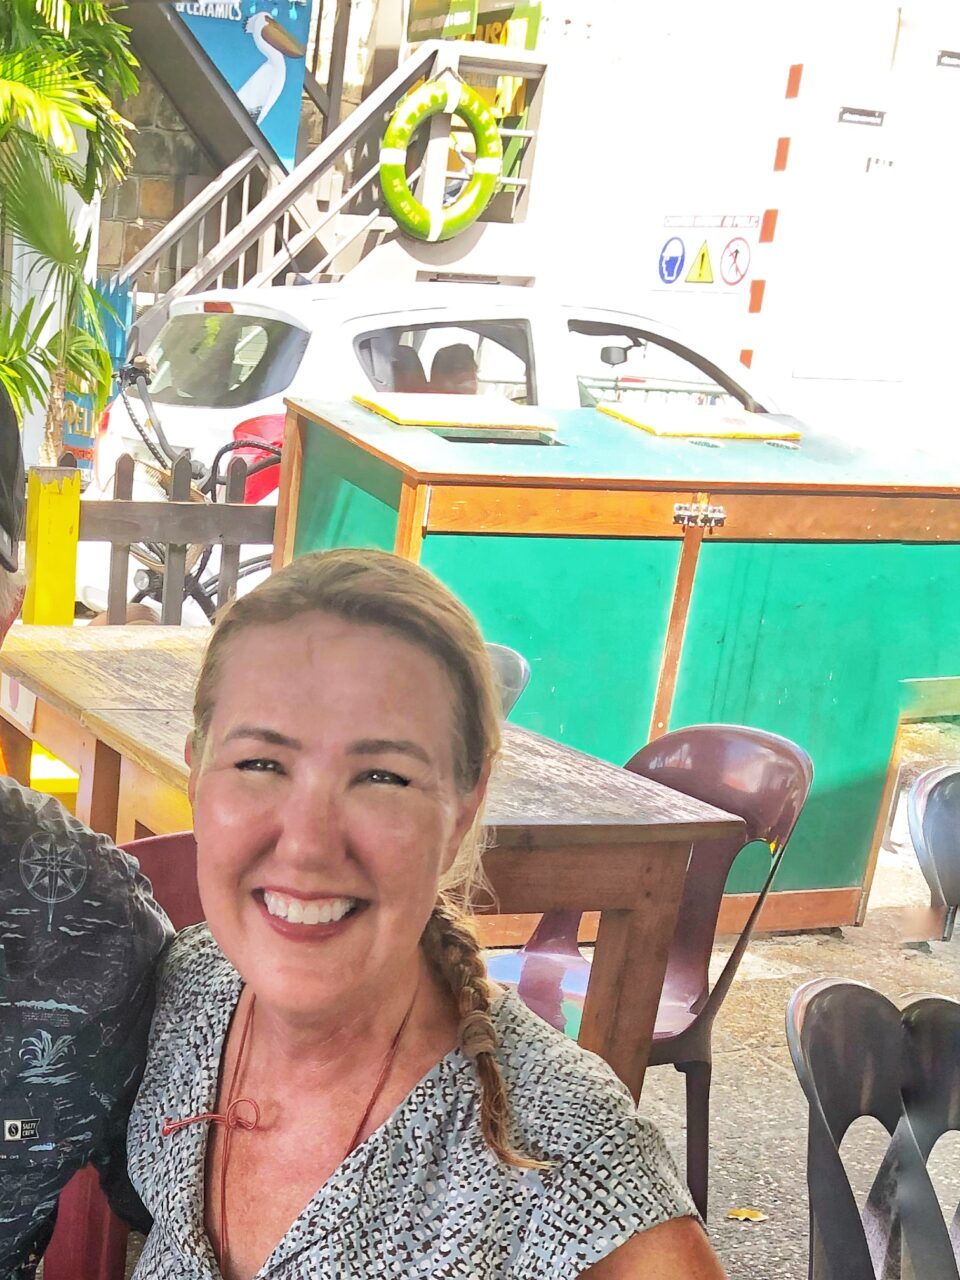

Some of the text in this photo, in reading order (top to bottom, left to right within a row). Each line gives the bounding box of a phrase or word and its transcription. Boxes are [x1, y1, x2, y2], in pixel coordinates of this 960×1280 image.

[186, 1, 242, 21] CERAMICS
[22, 1122, 36, 1130] SALTY
[22, 1129, 35, 1137] CREW
